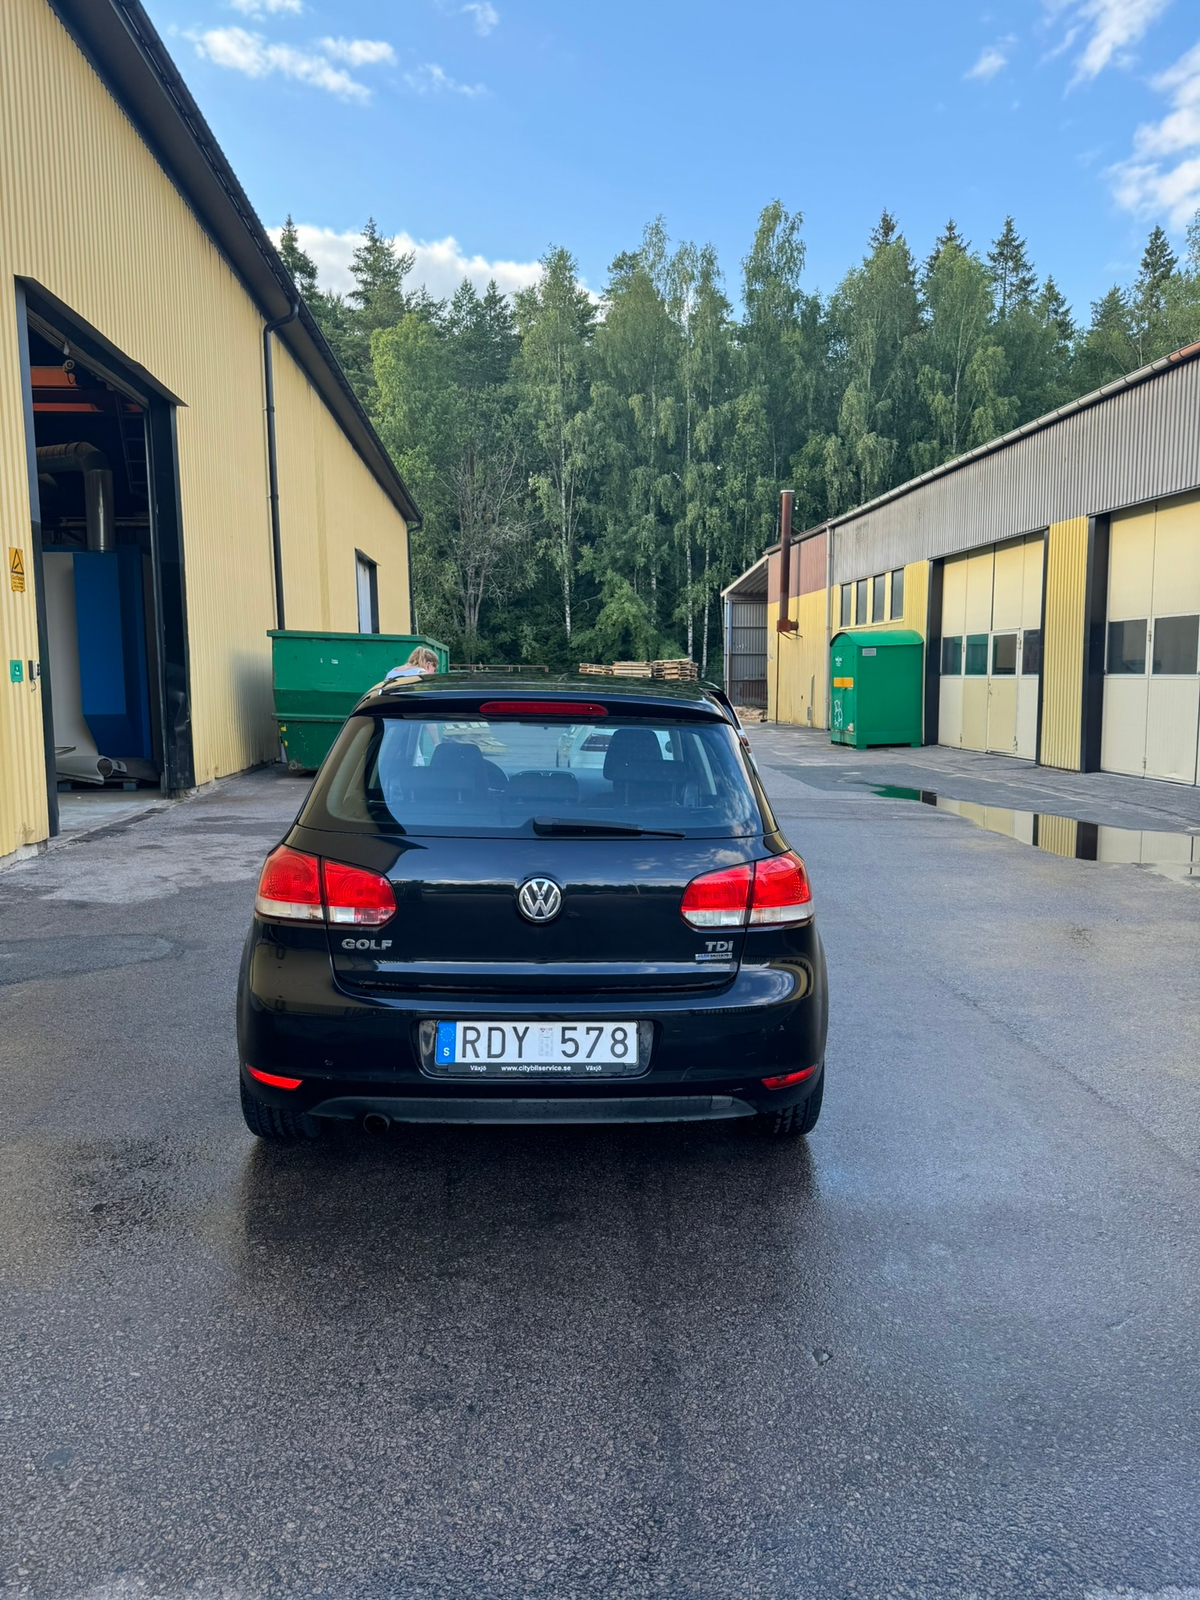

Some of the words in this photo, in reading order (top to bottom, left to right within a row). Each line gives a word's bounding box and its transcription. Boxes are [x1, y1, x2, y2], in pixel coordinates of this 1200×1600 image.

[519, 878, 561, 921] VW
[341, 938, 392, 950] GOLF
[705, 941, 733, 951] TDI
[461, 1026, 530, 1059] RDY
[561, 1026, 629, 1059] 578
[443, 1047, 450, 1056] S
